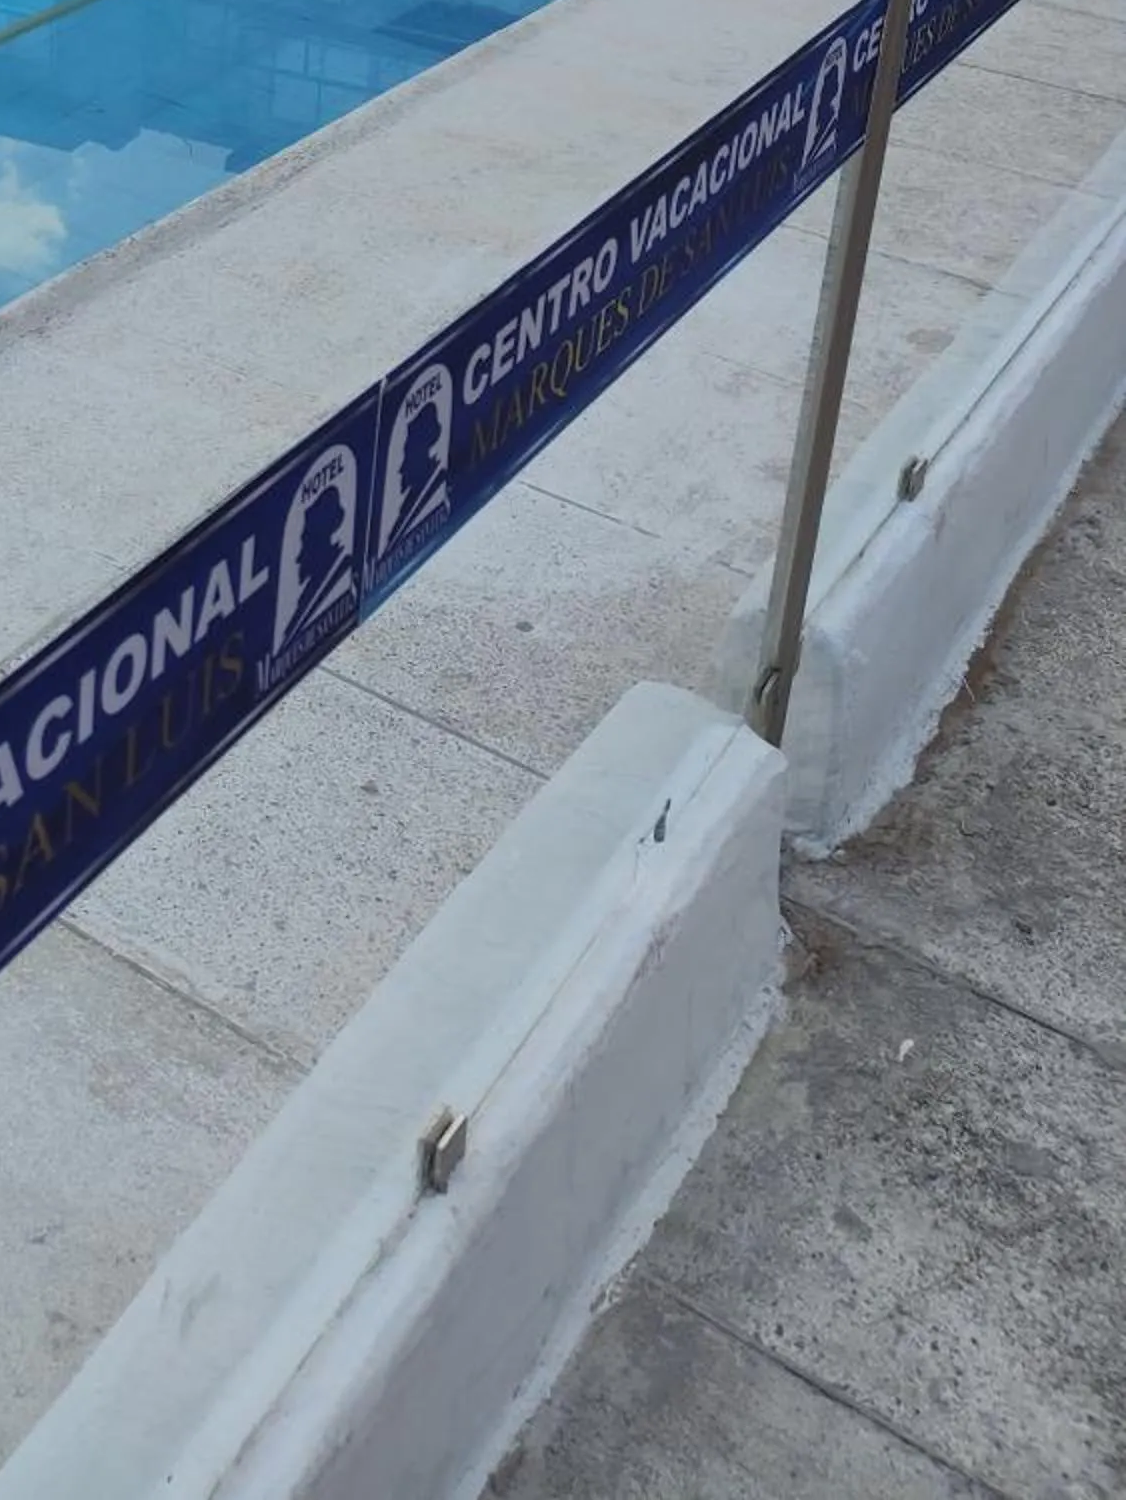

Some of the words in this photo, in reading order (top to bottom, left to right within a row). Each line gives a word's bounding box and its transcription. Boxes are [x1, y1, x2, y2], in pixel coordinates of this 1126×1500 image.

[463, 237, 618, 405] CENTRO
[630, 83, 805, 264] VACACIONAL
[404, 369, 444, 421] HOTEL
[471, 285, 632, 465] MARQUES
[299, 452, 345, 504] HOTEL
[122, 631, 245, 790] LUIS
